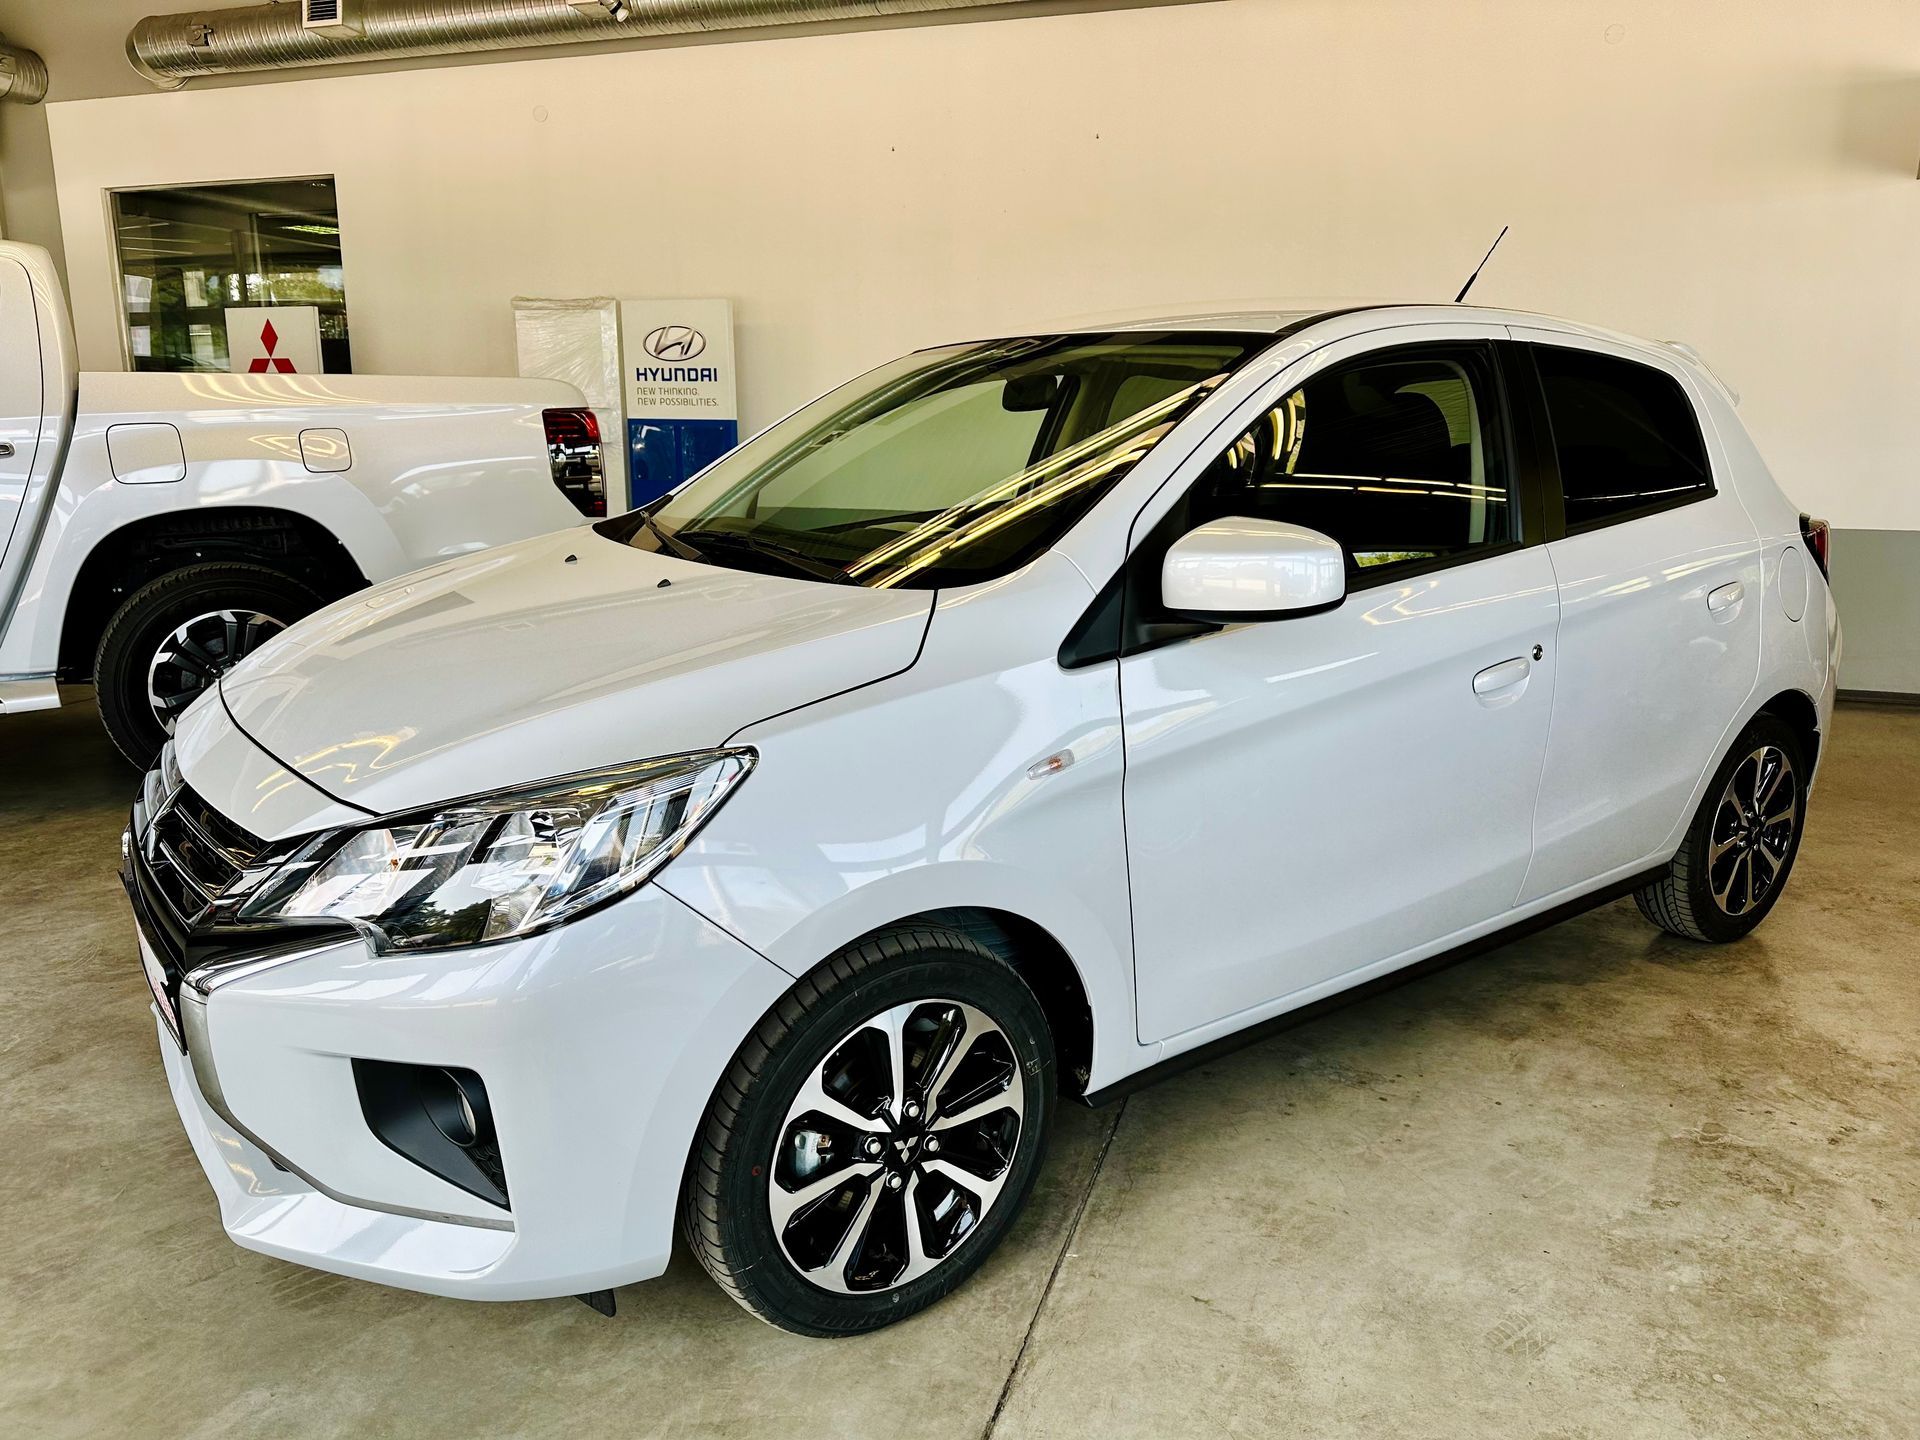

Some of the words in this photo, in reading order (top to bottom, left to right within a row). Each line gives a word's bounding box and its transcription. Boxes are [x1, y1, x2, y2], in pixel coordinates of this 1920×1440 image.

[636, 367, 718, 382] HYUNDAI
[636, 387, 656, 395] NEW
[658, 387, 700, 396] THINKING.
[637, 397, 657, 406] NEW
[659, 397, 719, 407] POSSIBILITIES.
